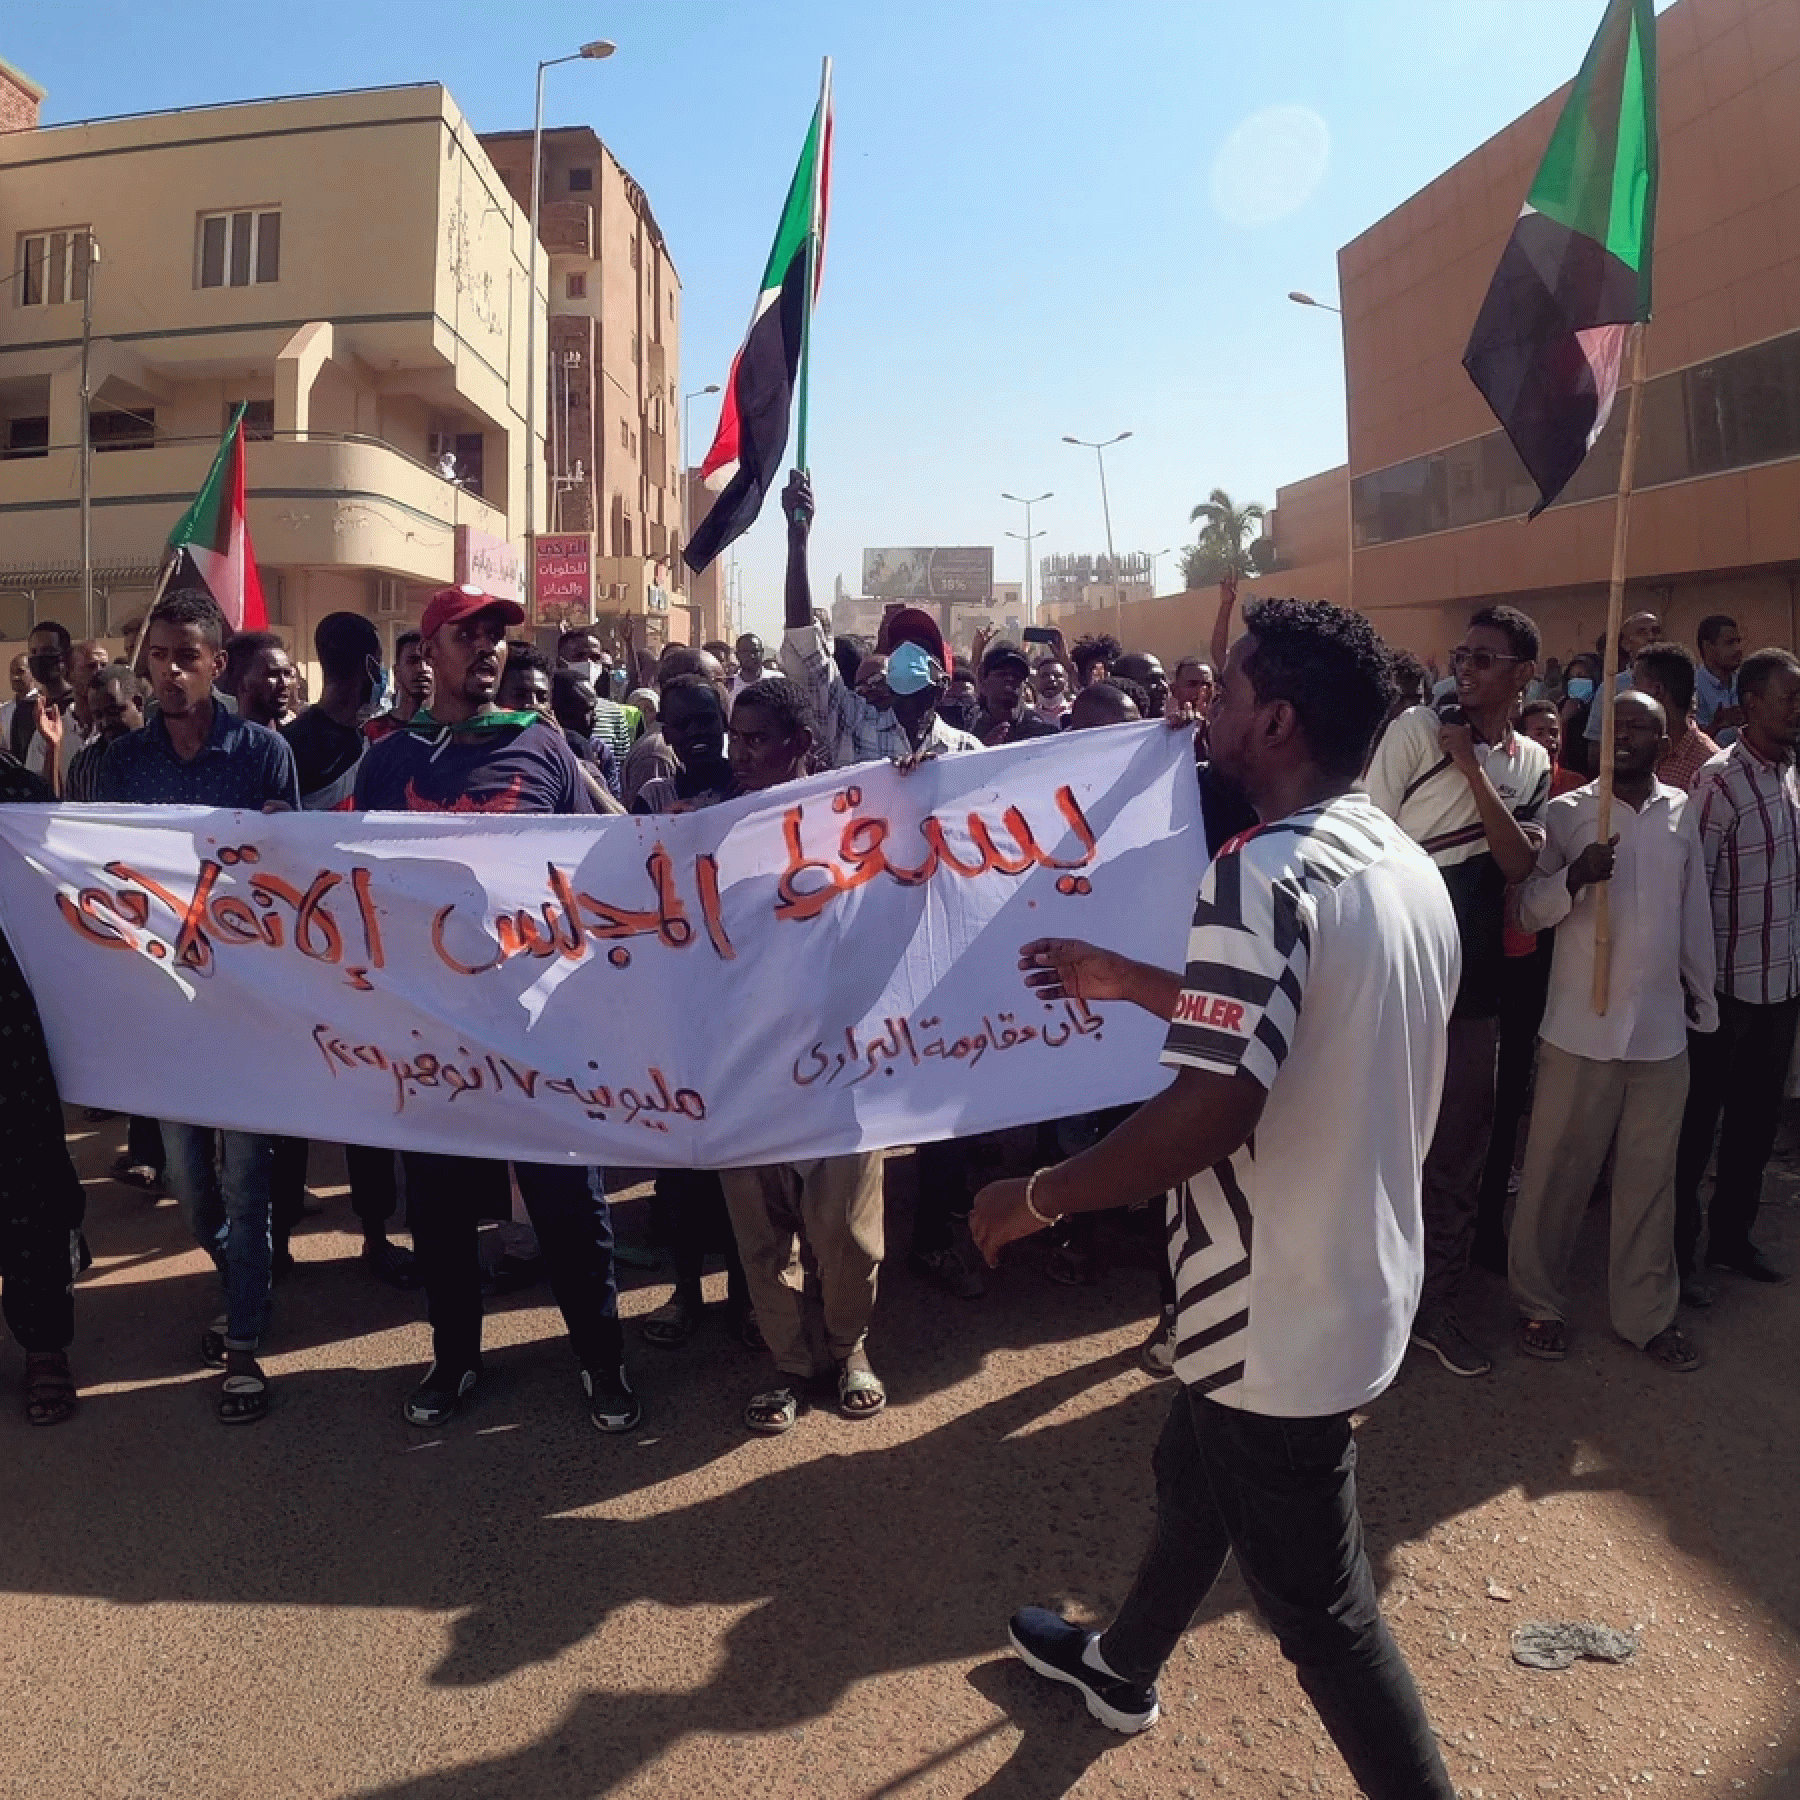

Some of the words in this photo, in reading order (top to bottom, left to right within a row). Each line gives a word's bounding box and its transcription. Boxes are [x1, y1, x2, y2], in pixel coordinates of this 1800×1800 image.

[539, 561, 587, 578] للحلويات
[774, 785, 1098, 921] يسقط
[432, 847, 736, 976] المجلس
[923, 1011, 1038, 1069] مقاومة
